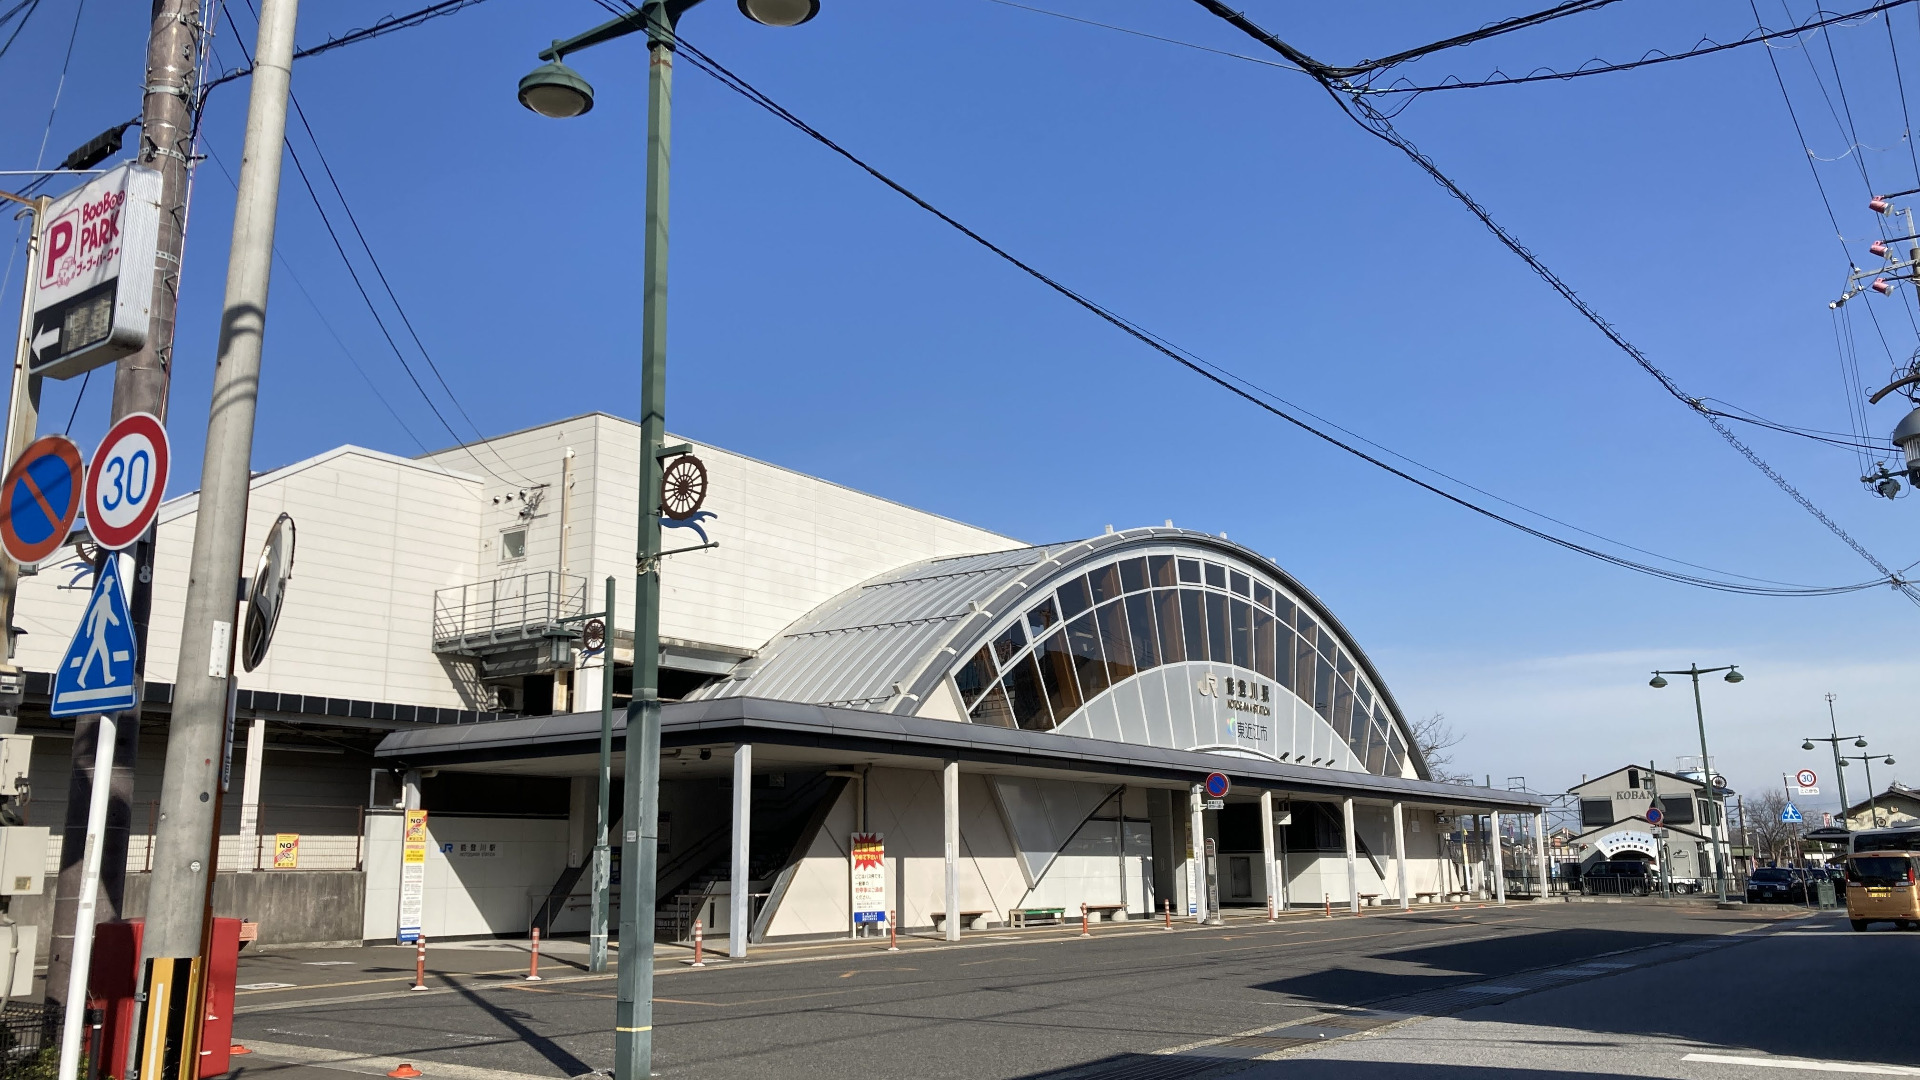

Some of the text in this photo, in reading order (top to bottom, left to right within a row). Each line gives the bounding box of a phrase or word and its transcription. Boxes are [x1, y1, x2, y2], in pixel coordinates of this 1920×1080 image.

[79, 210, 120, 257] PARK
[45, 220, 73, 280] P
[102, 450, 149, 511] 30
[1197, 671, 1219, 699] JR
[1236, 721, 1268, 742] 東近江市
[1801, 774, 1813, 783] 30
[1616, 790, 1655, 800] KOBAN
[439, 843, 454, 853] JR
